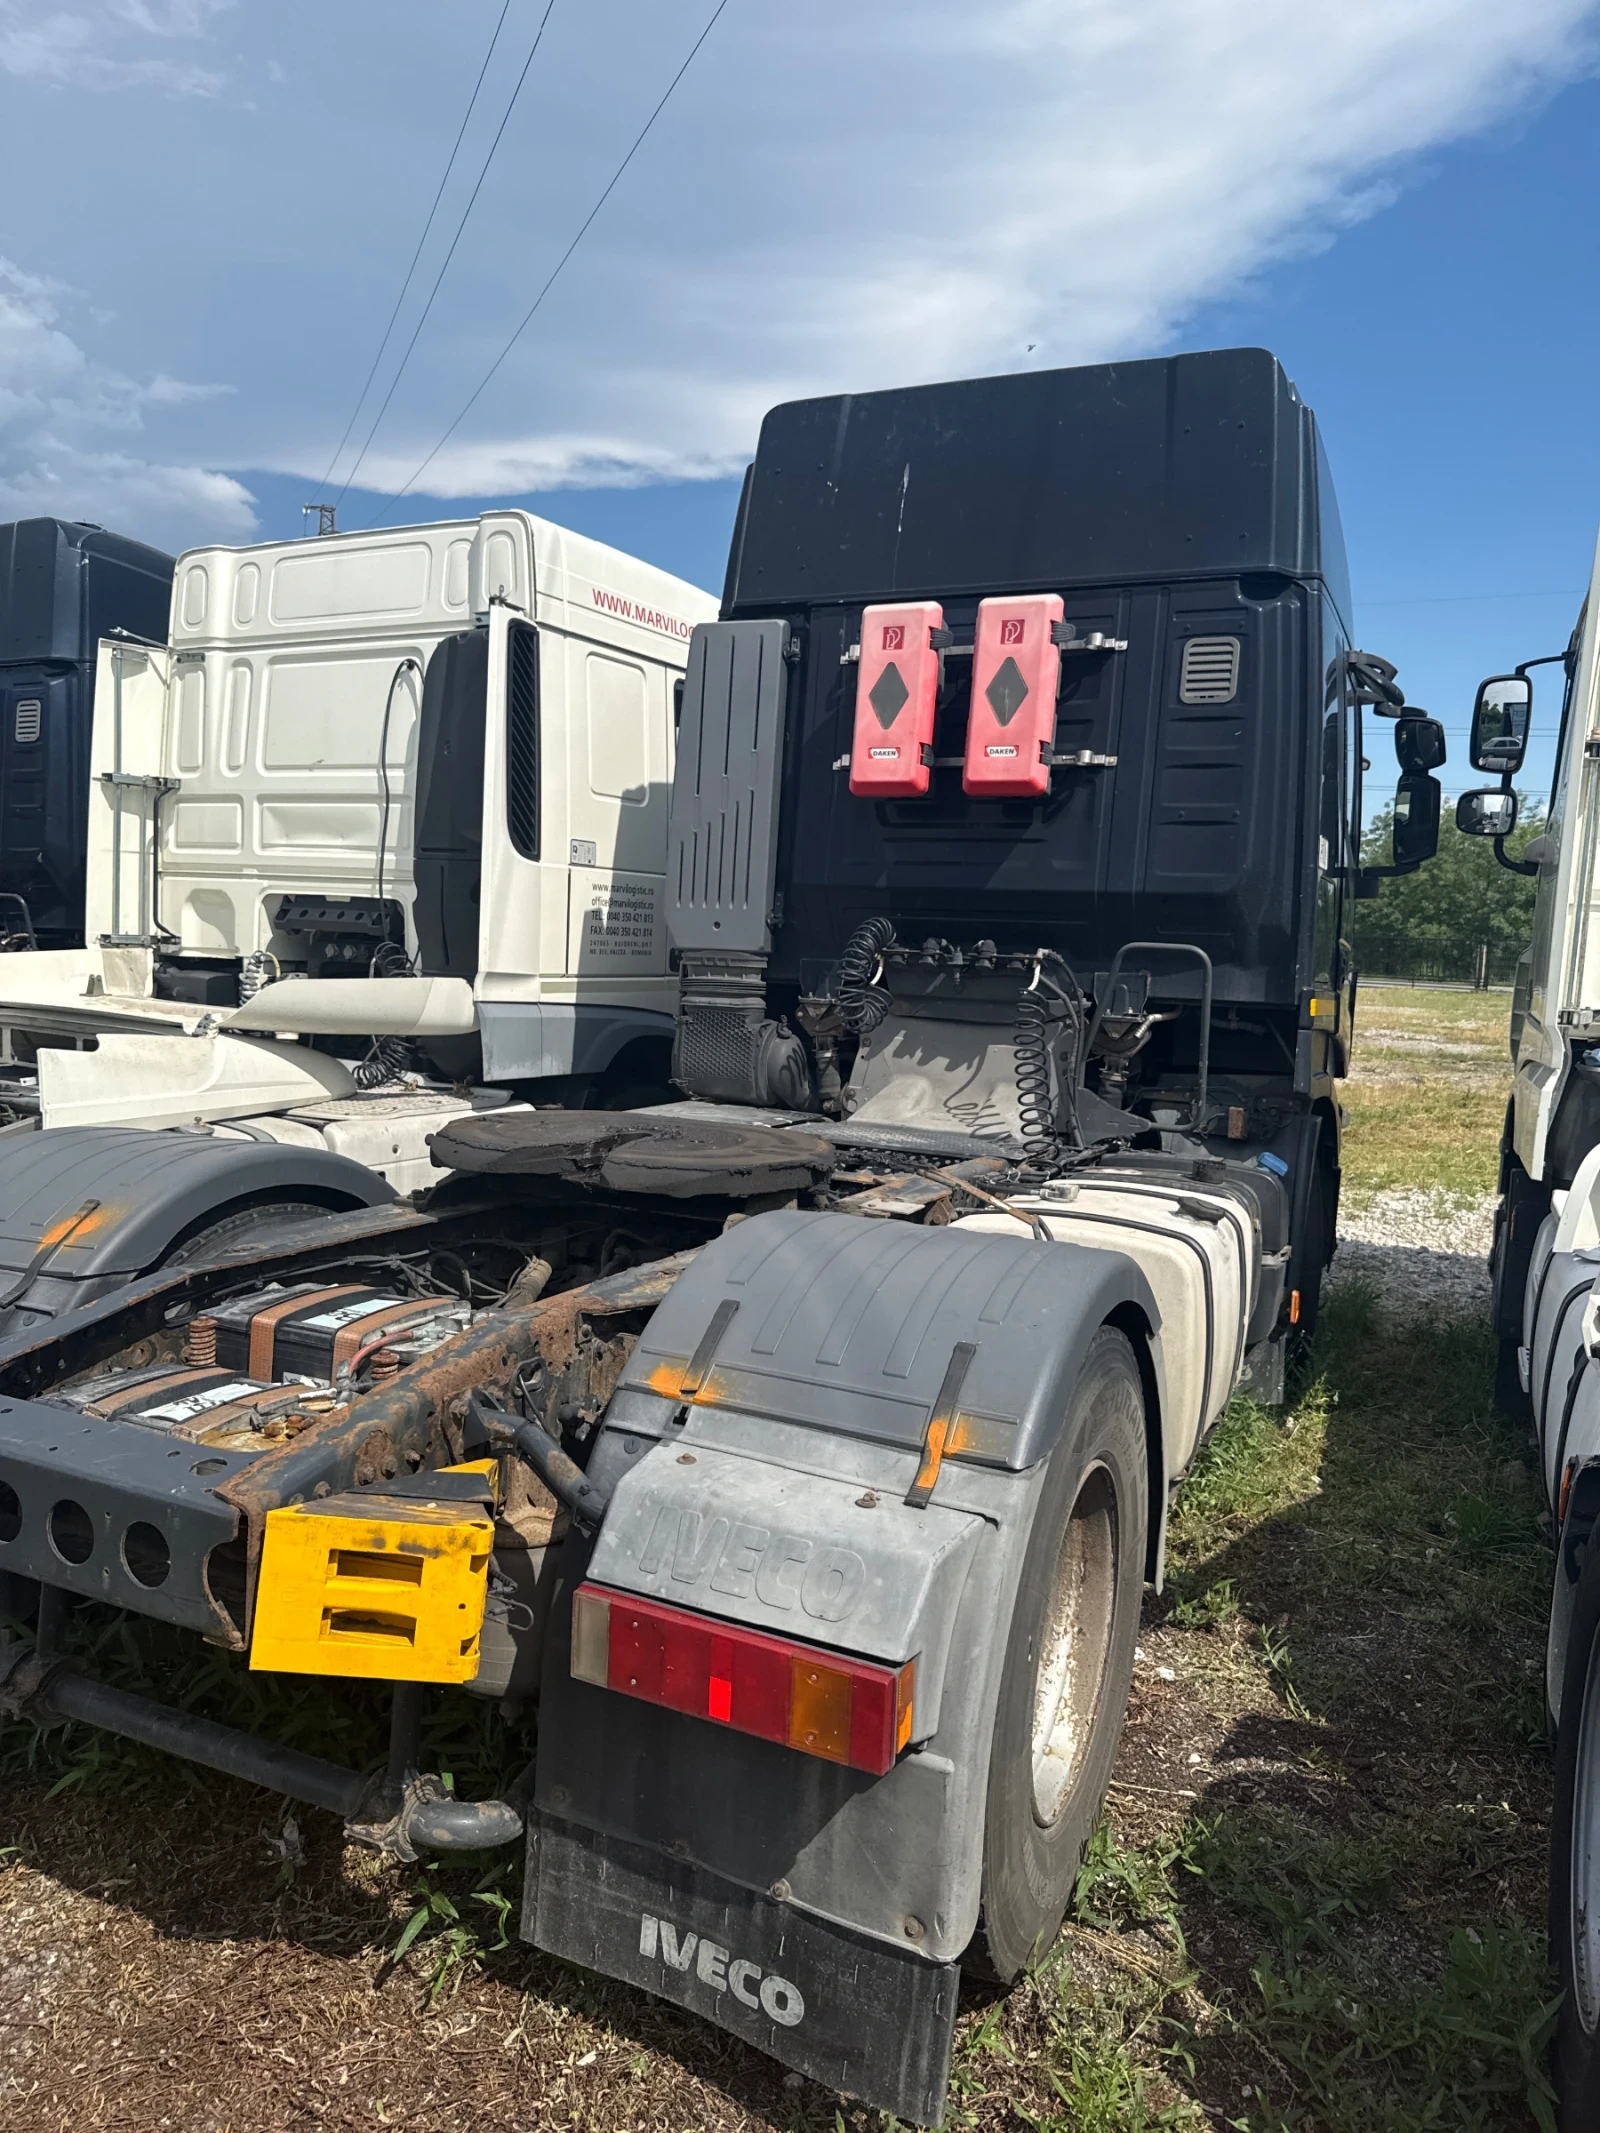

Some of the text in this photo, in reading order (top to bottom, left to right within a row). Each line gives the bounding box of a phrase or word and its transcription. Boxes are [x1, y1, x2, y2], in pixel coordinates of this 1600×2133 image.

[592, 883, 654, 896] www.marvilogistic.ro
[591, 896, 654, 911] office@marvilogistic.ro
[607, 911, 620, 921] 0040
[621, 912, 632, 922] 350
[633, 912, 643, 923] 421
[644, 914, 654, 923] 813
[606, 926, 619, 936] 0040
[620, 927, 631, 937] 350
[632, 928, 642, 937] 421
[642, 928, 653, 938] 814
[639, 1505, 865, 1622] IVECO
[639, 1913, 805, 2027] IVECO
